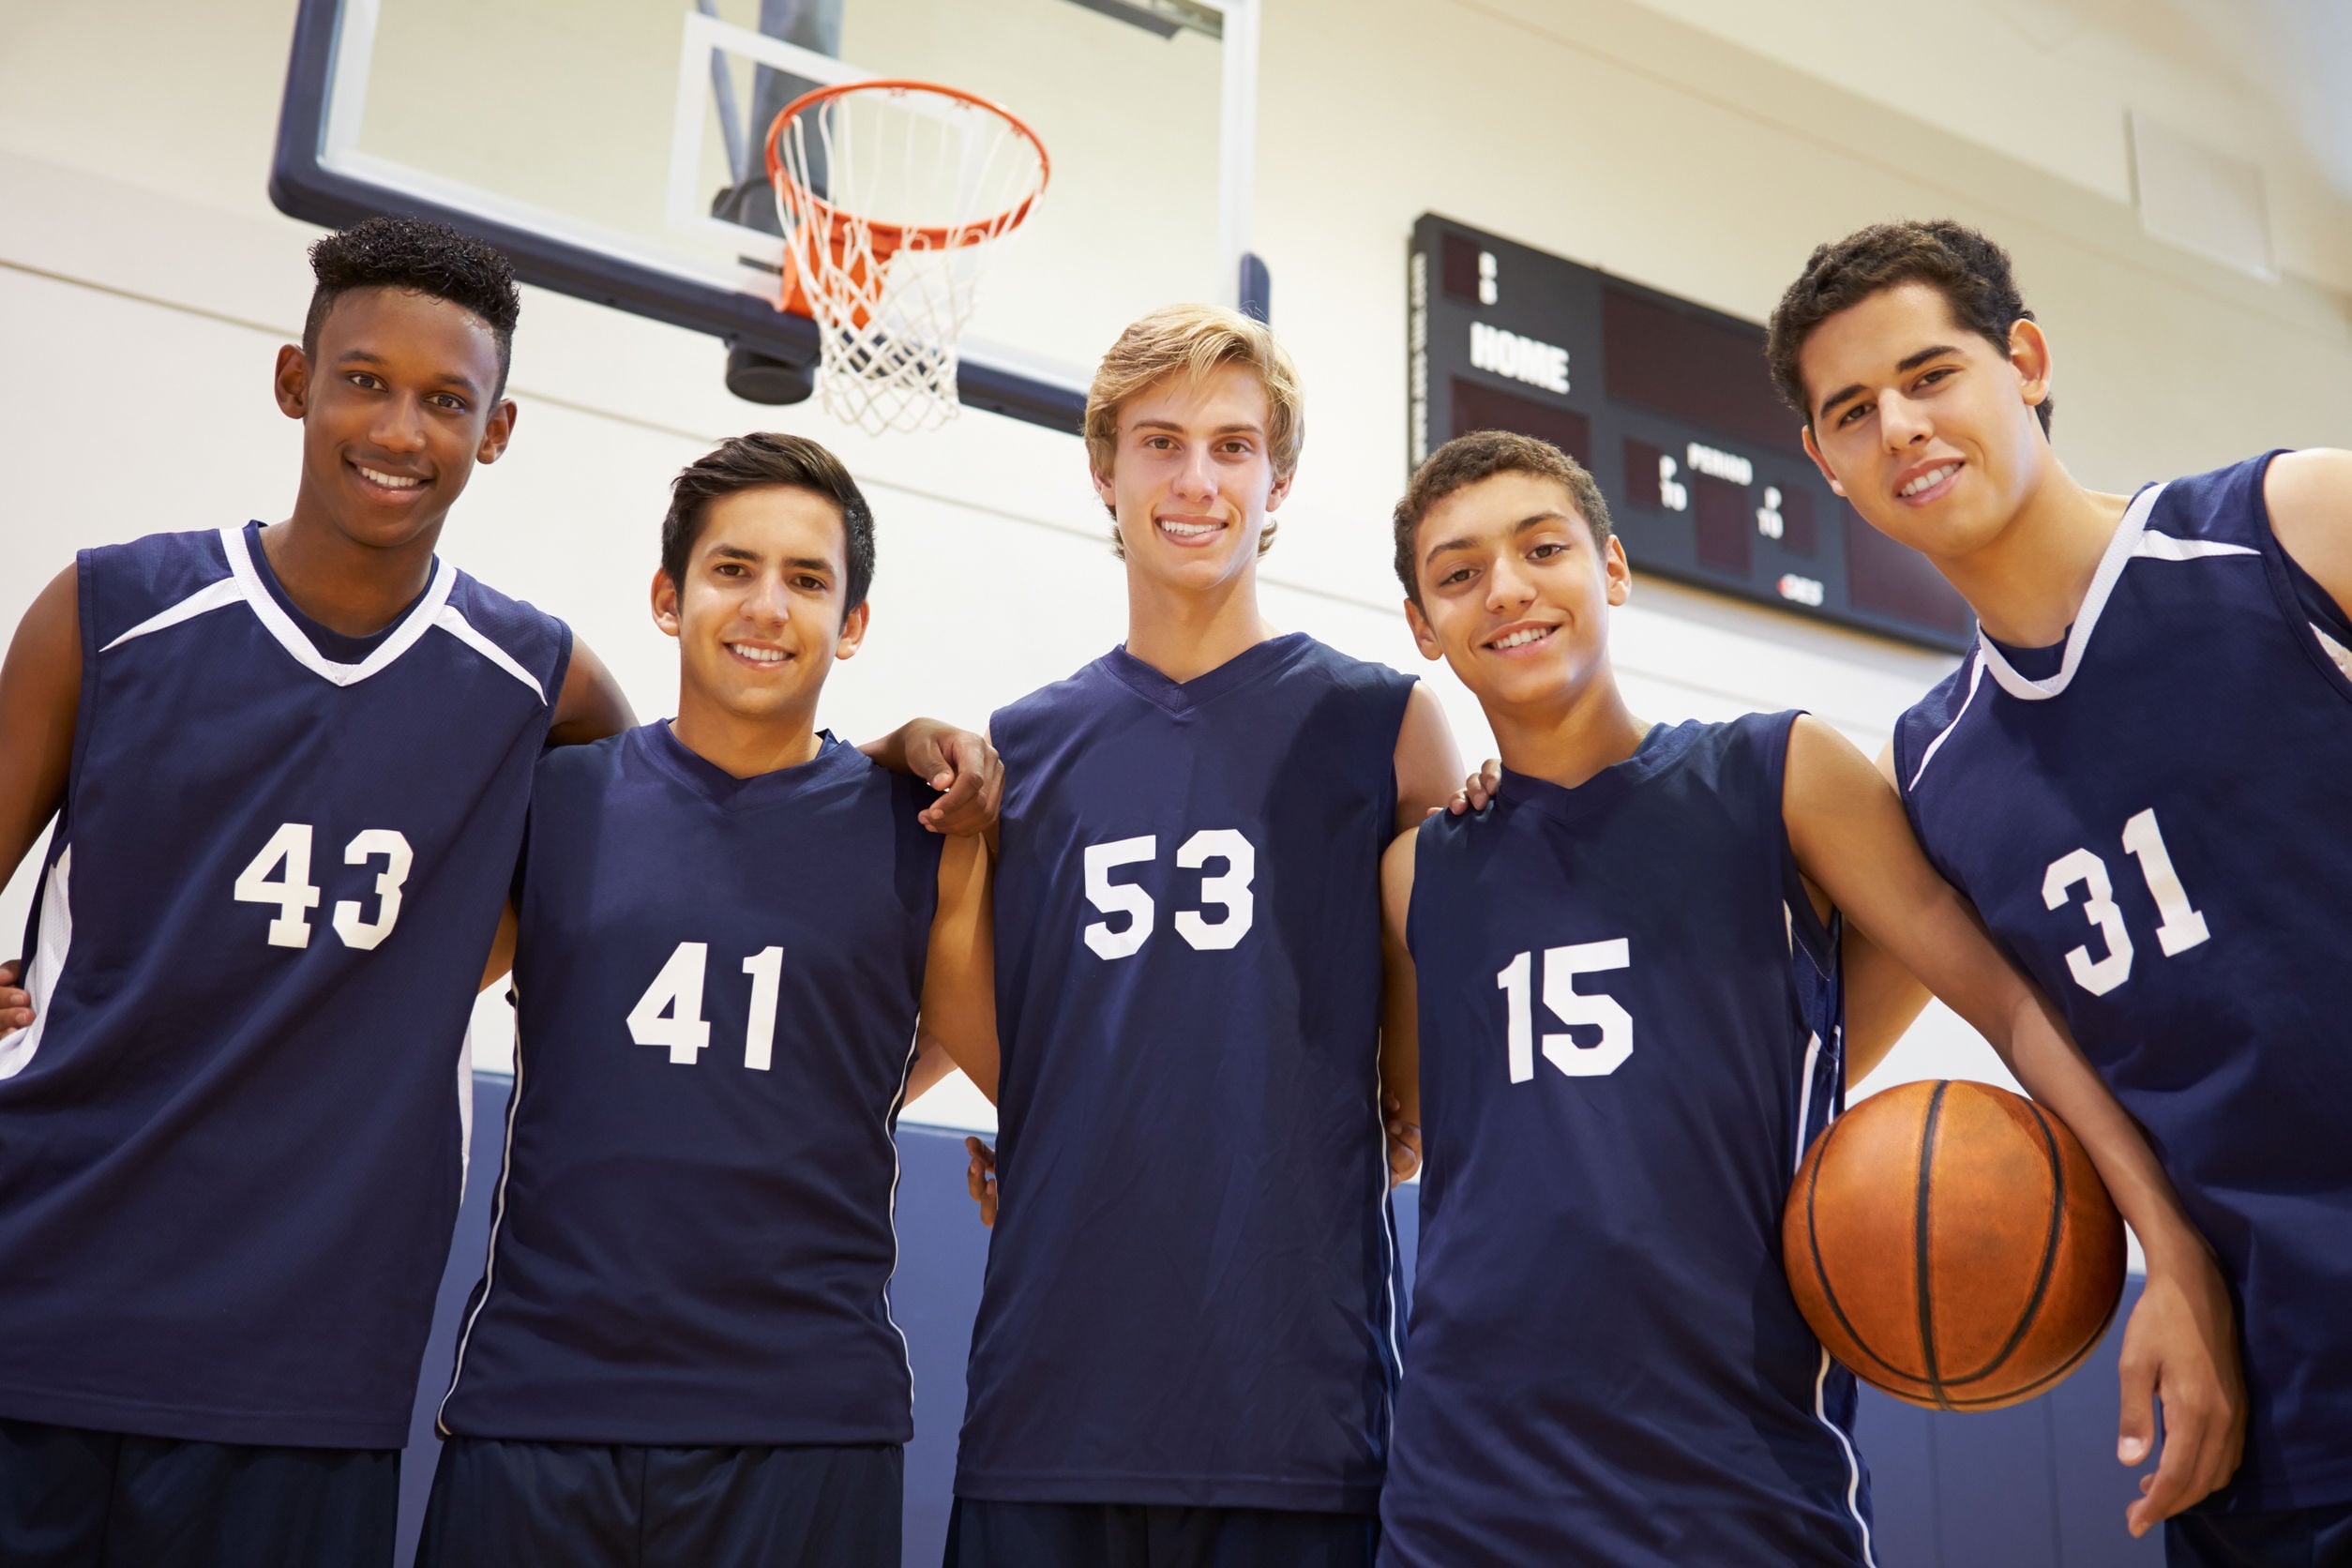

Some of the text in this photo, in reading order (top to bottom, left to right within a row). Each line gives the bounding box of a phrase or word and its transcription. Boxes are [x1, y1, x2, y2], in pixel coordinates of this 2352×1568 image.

[1470, 322, 1570, 394] HOME
[1687, 443, 1753, 486] PERIOD
[234, 822, 414, 951] 43
[1083, 828, 1255, 961] 53
[2042, 807, 2210, 997] 31
[626, 942, 784, 1071] 41
[1497, 937, 1634, 1084] 15
